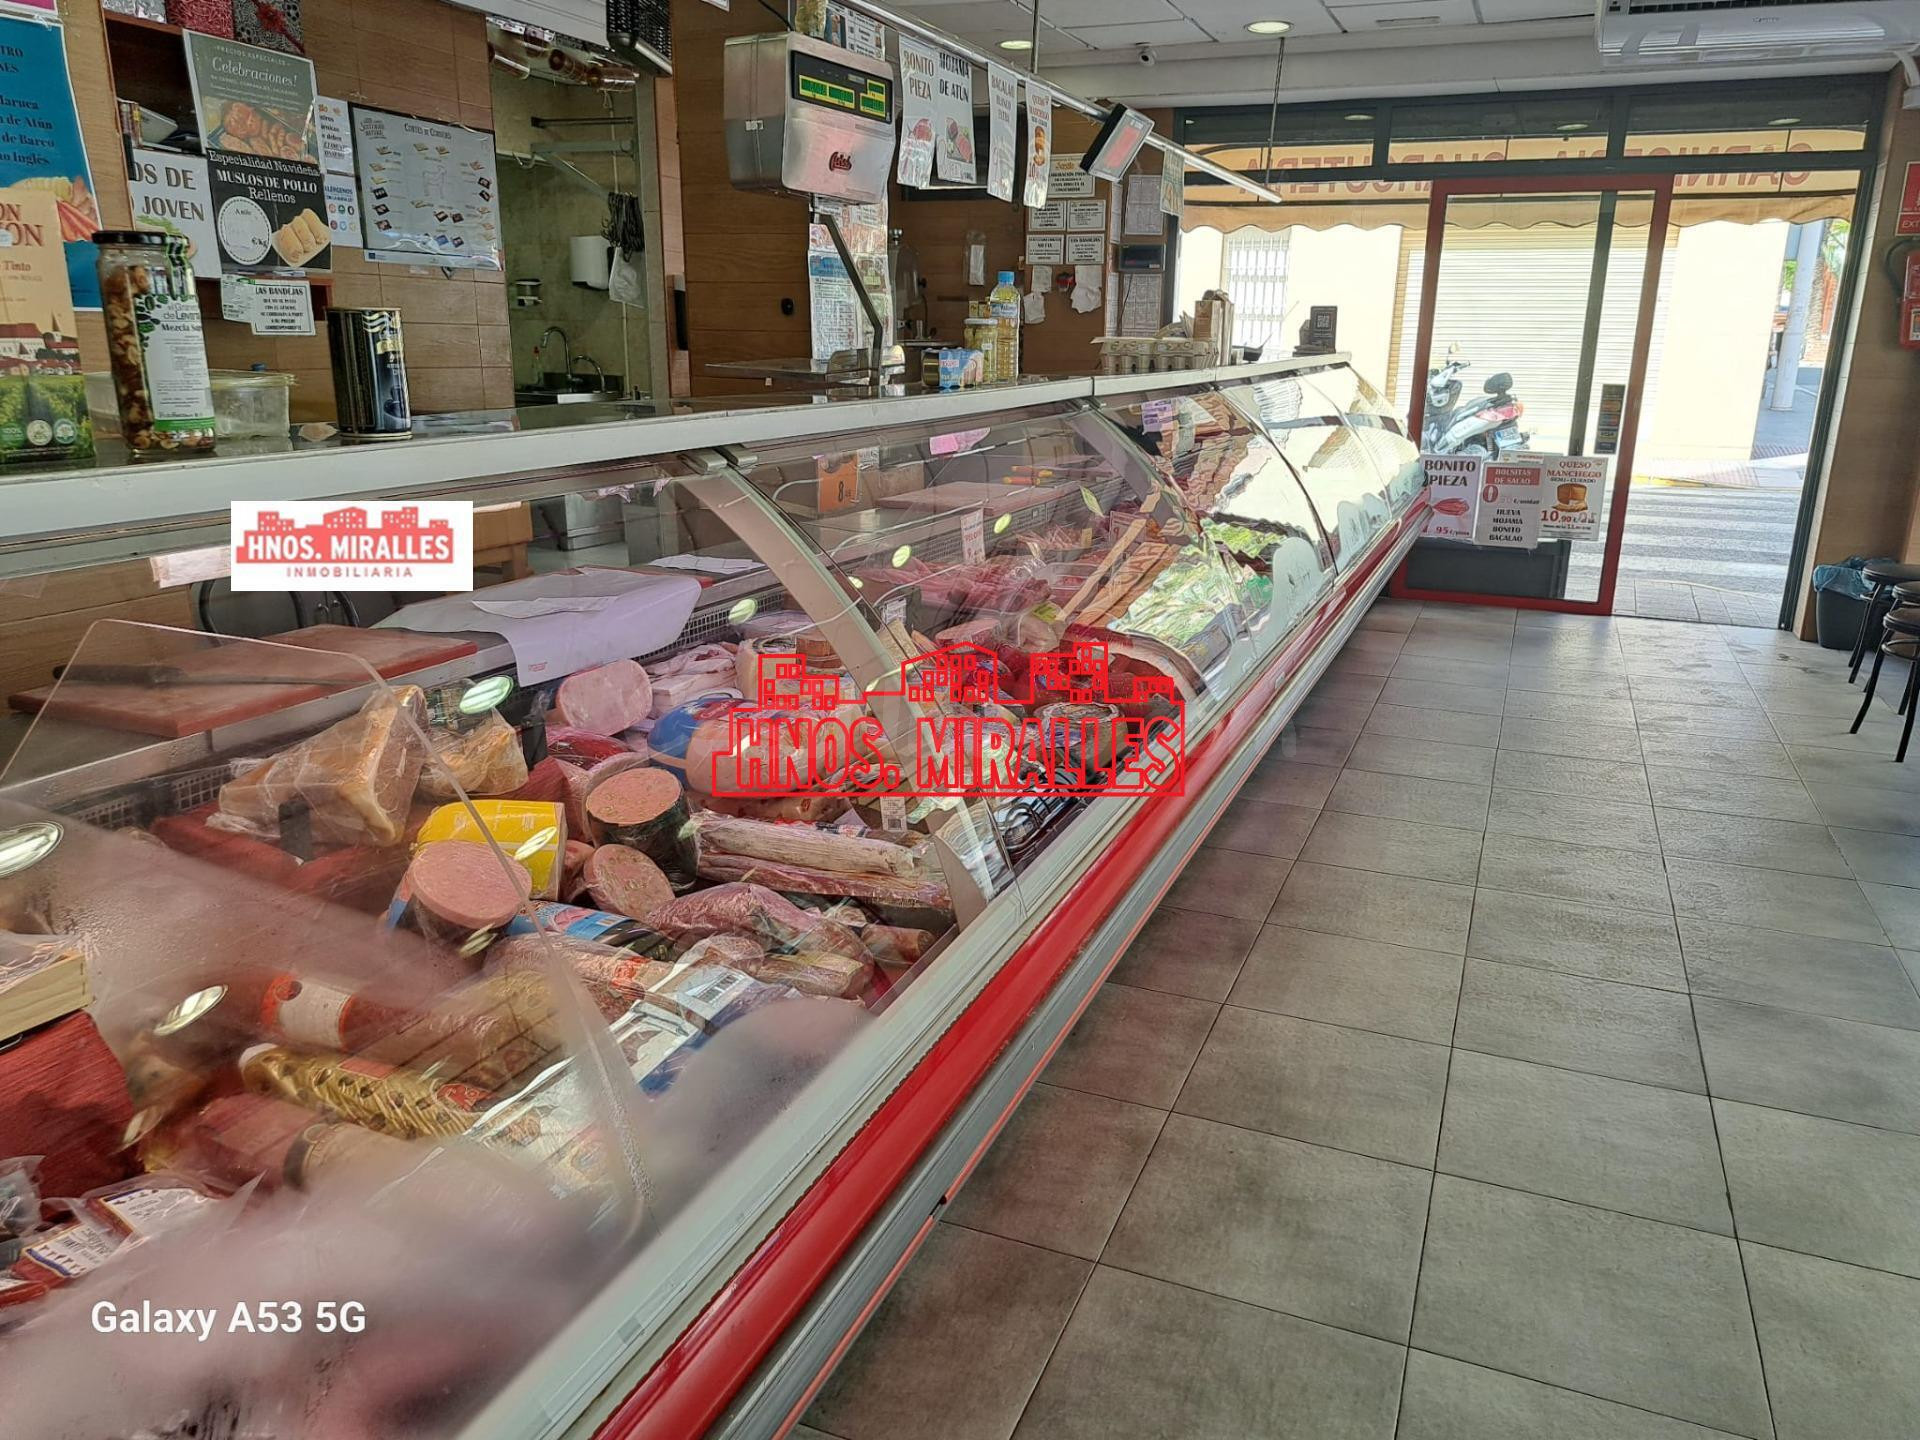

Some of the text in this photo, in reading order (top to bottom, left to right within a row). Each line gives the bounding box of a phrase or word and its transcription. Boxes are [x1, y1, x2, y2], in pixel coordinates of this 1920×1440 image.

[211, 55, 298, 88] Celebraciones!
[904, 50, 934, 78] BONITO
[909, 77, 932, 101] PIEZA
[939, 78, 949, 96] DE
[208, 150, 273, 171] Especialidad
[164, 166, 197, 190] DE
[216, 168, 318, 194] MUSLOS DE POLLO
[248, 187, 297, 205] Rellenos
[142, 195, 205, 222] JOVEN
[268, 287, 304, 296] BANDEJAS
[1424, 459, 1476, 472] BONITO
[1546, 470, 1602, 478] MANCHEGO
[1559, 461, 1592, 469] QUESO
[1430, 474, 1468, 487] PIEZA
